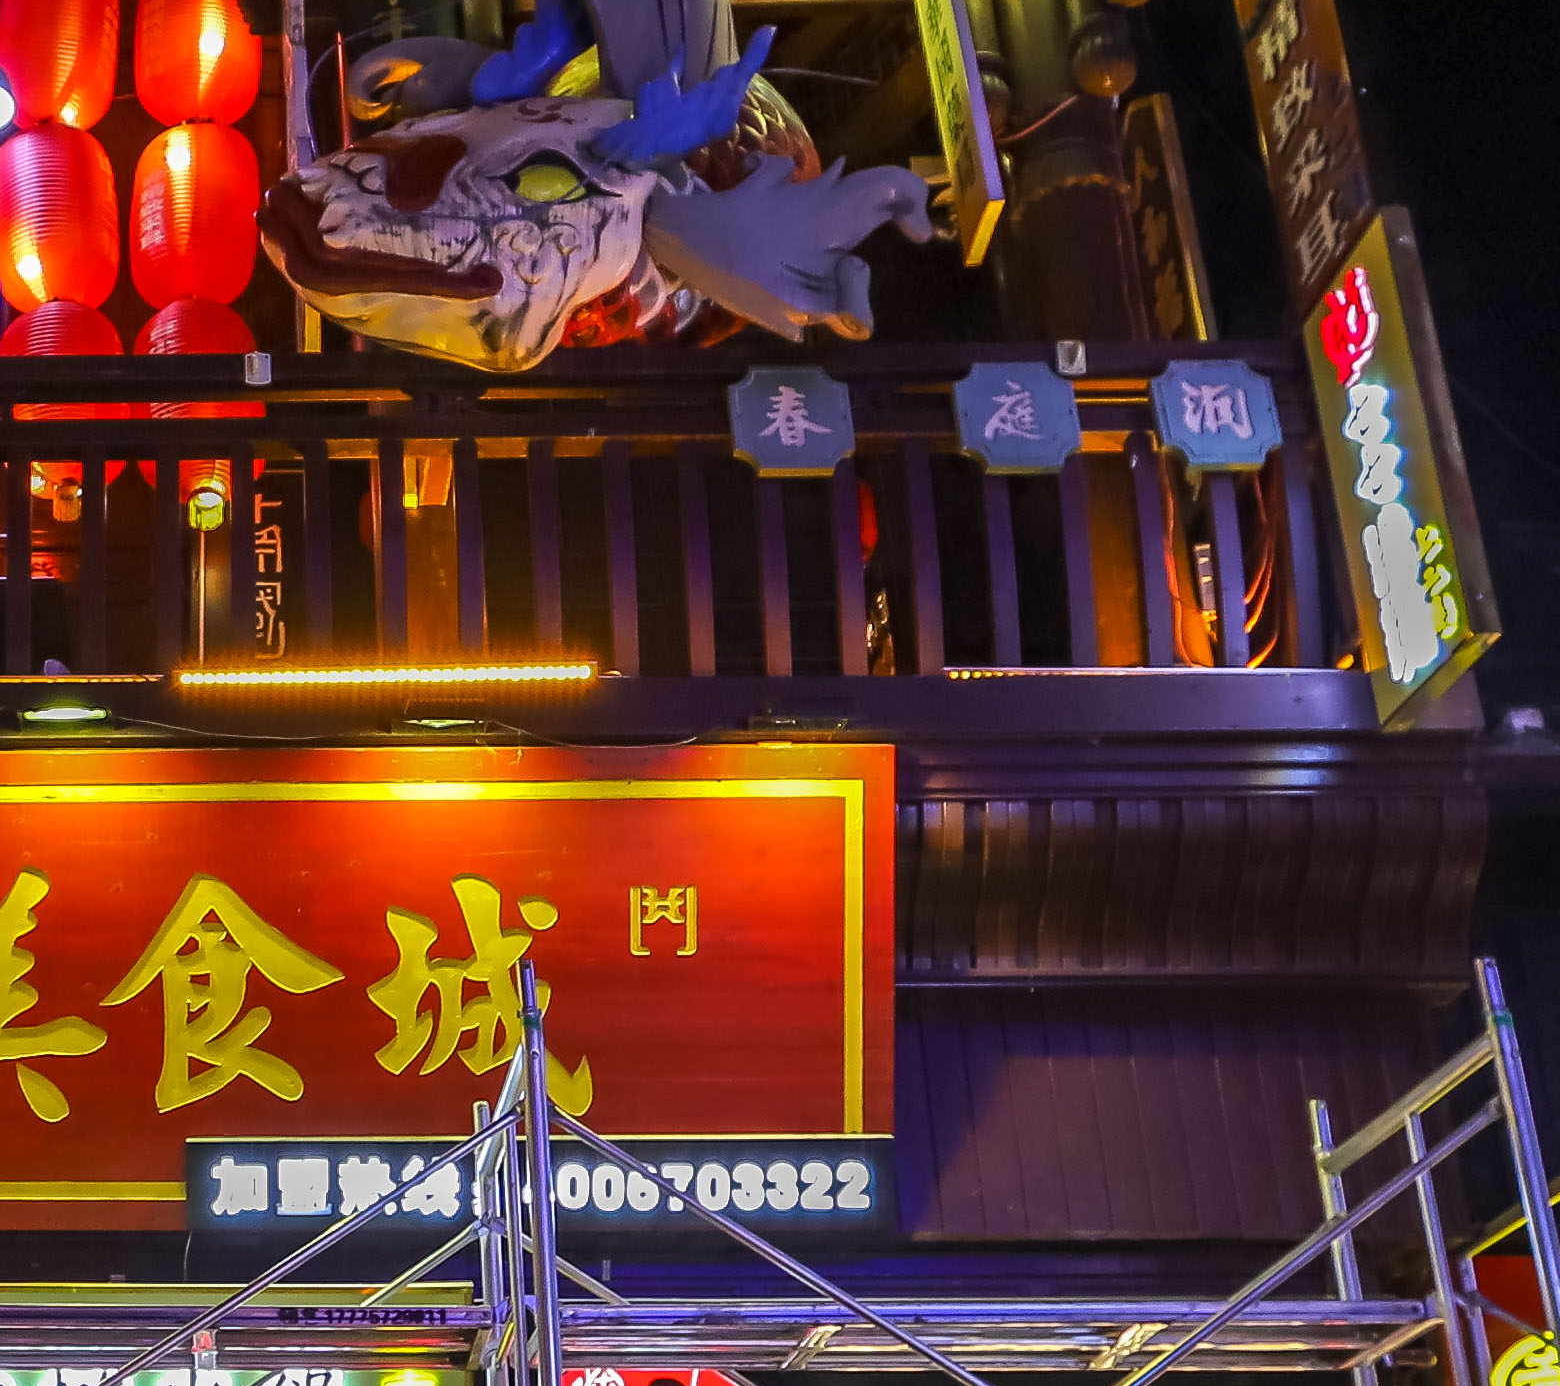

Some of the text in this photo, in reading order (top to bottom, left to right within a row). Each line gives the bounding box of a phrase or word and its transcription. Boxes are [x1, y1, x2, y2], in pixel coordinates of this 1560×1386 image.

[759, 384, 834, 449] 春
[982, 379, 1045, 443] 庭
[532, 1155, 873, 1214] 006703322
